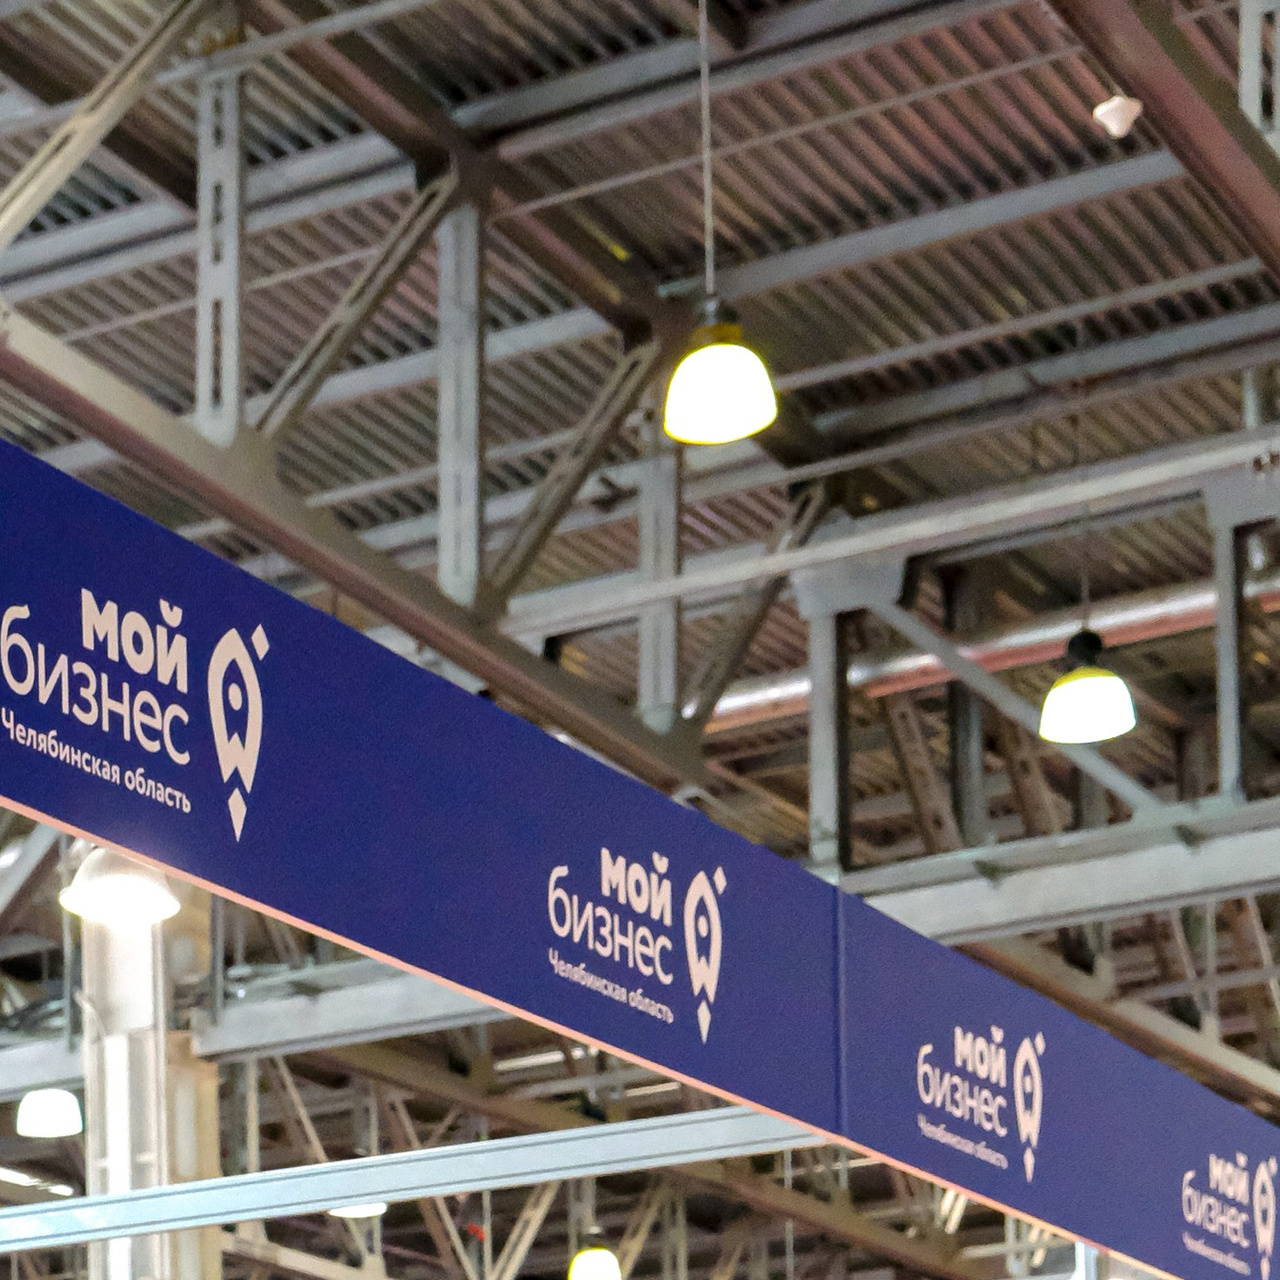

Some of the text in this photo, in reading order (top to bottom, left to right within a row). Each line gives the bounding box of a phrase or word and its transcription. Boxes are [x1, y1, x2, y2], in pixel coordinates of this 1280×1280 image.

[0, 604, 191, 765] бизнес
[1, 706, 191, 813] Челябинская область
[547, 865, 674, 985] бизнес
[917, 1043, 1008, 1138] бизнес
